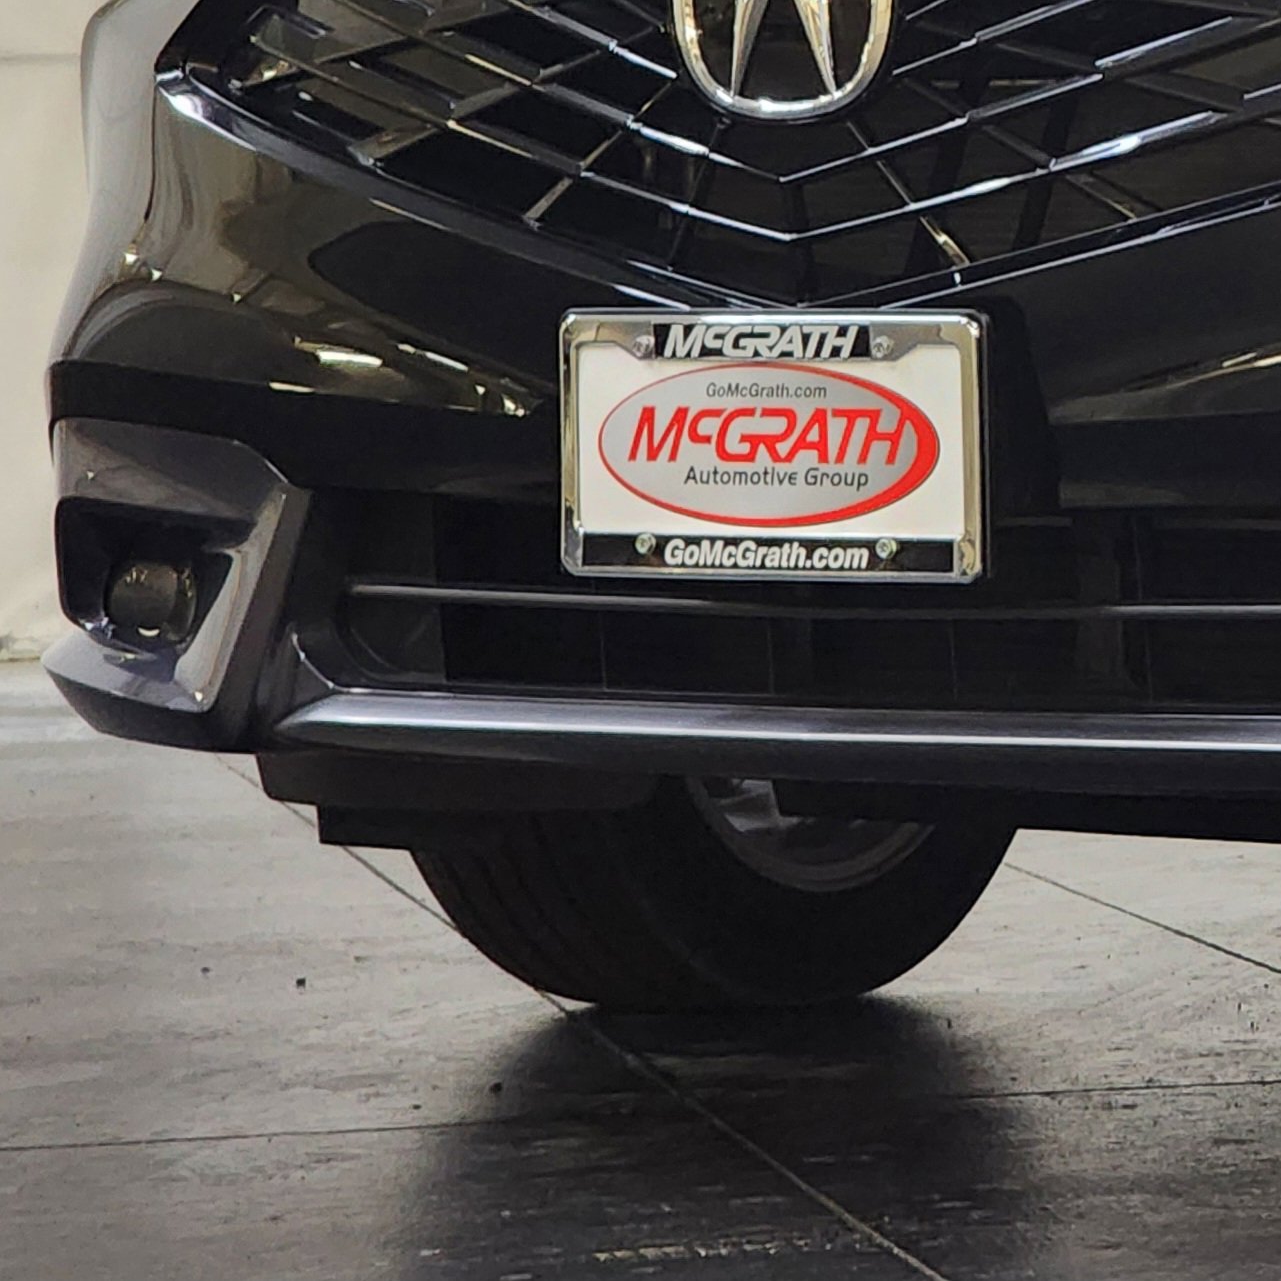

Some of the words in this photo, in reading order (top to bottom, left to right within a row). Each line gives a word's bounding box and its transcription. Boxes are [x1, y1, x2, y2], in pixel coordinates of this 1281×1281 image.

[663, 323, 860, 359] McGRATH
[705, 382, 828, 400] GoMcGrath.com
[627, 405, 910, 466] McGRATH
[683, 466, 799, 487] Automotive
[804, 467, 870, 492] Group
[663, 538, 870, 571] GoMcGrath.com
